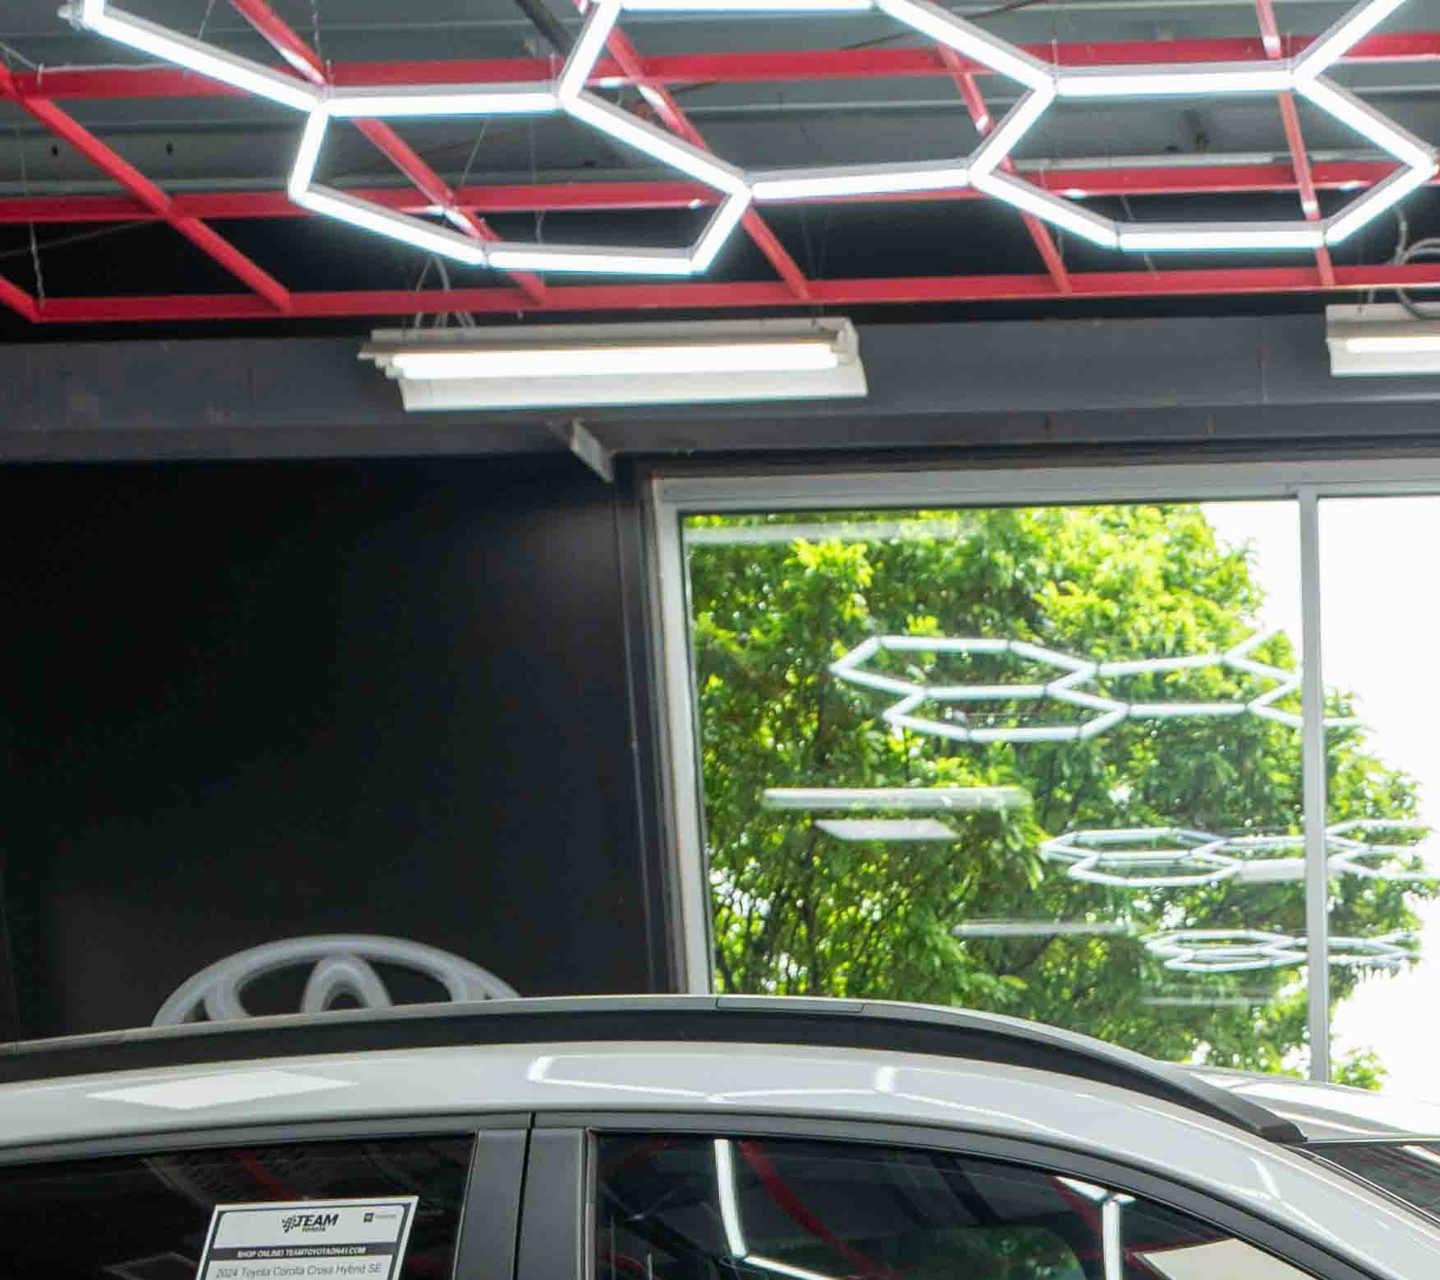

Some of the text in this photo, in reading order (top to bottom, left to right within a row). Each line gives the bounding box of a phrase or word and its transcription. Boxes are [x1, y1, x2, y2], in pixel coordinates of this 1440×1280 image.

[296, 1213, 339, 1227] TEAM
[237, 1249, 256, 1258] SHOP
[216, 1262, 382, 1279] 2024 Toyota Corolla Cross Hybrid SE
